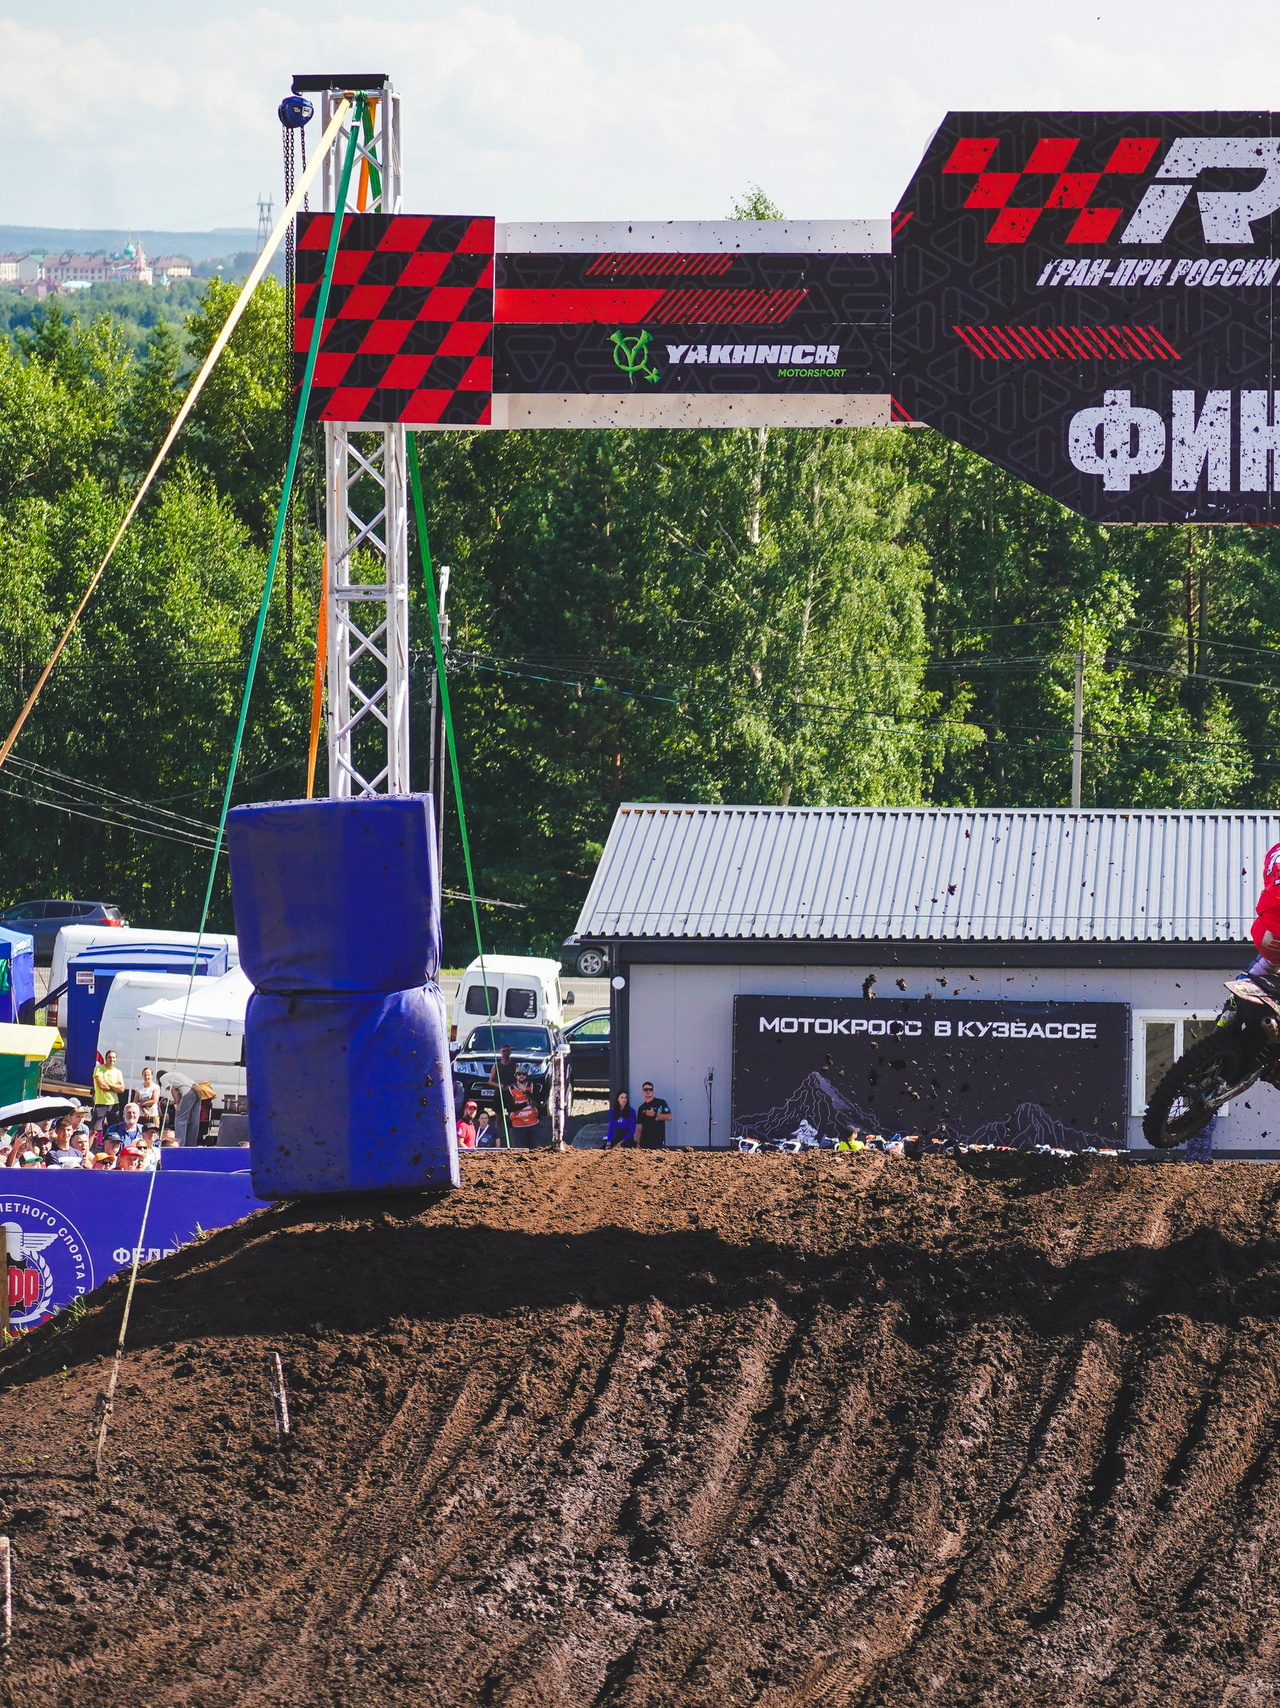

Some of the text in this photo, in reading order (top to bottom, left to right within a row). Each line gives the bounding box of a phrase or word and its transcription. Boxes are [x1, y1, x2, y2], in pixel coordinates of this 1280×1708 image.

[1036, 258, 1171, 288] ГРАН-ПРИ
[1170, 258, 1280, 288] РОССИИ
[666, 344, 841, 365] YAKHNICH
[777, 368, 847, 378] MOTORSPORT
[759, 1016, 1097, 1040] МОТОКРОСС В КУЗБАССЕ
[58, 1227, 86, 1280] СПОРТА
